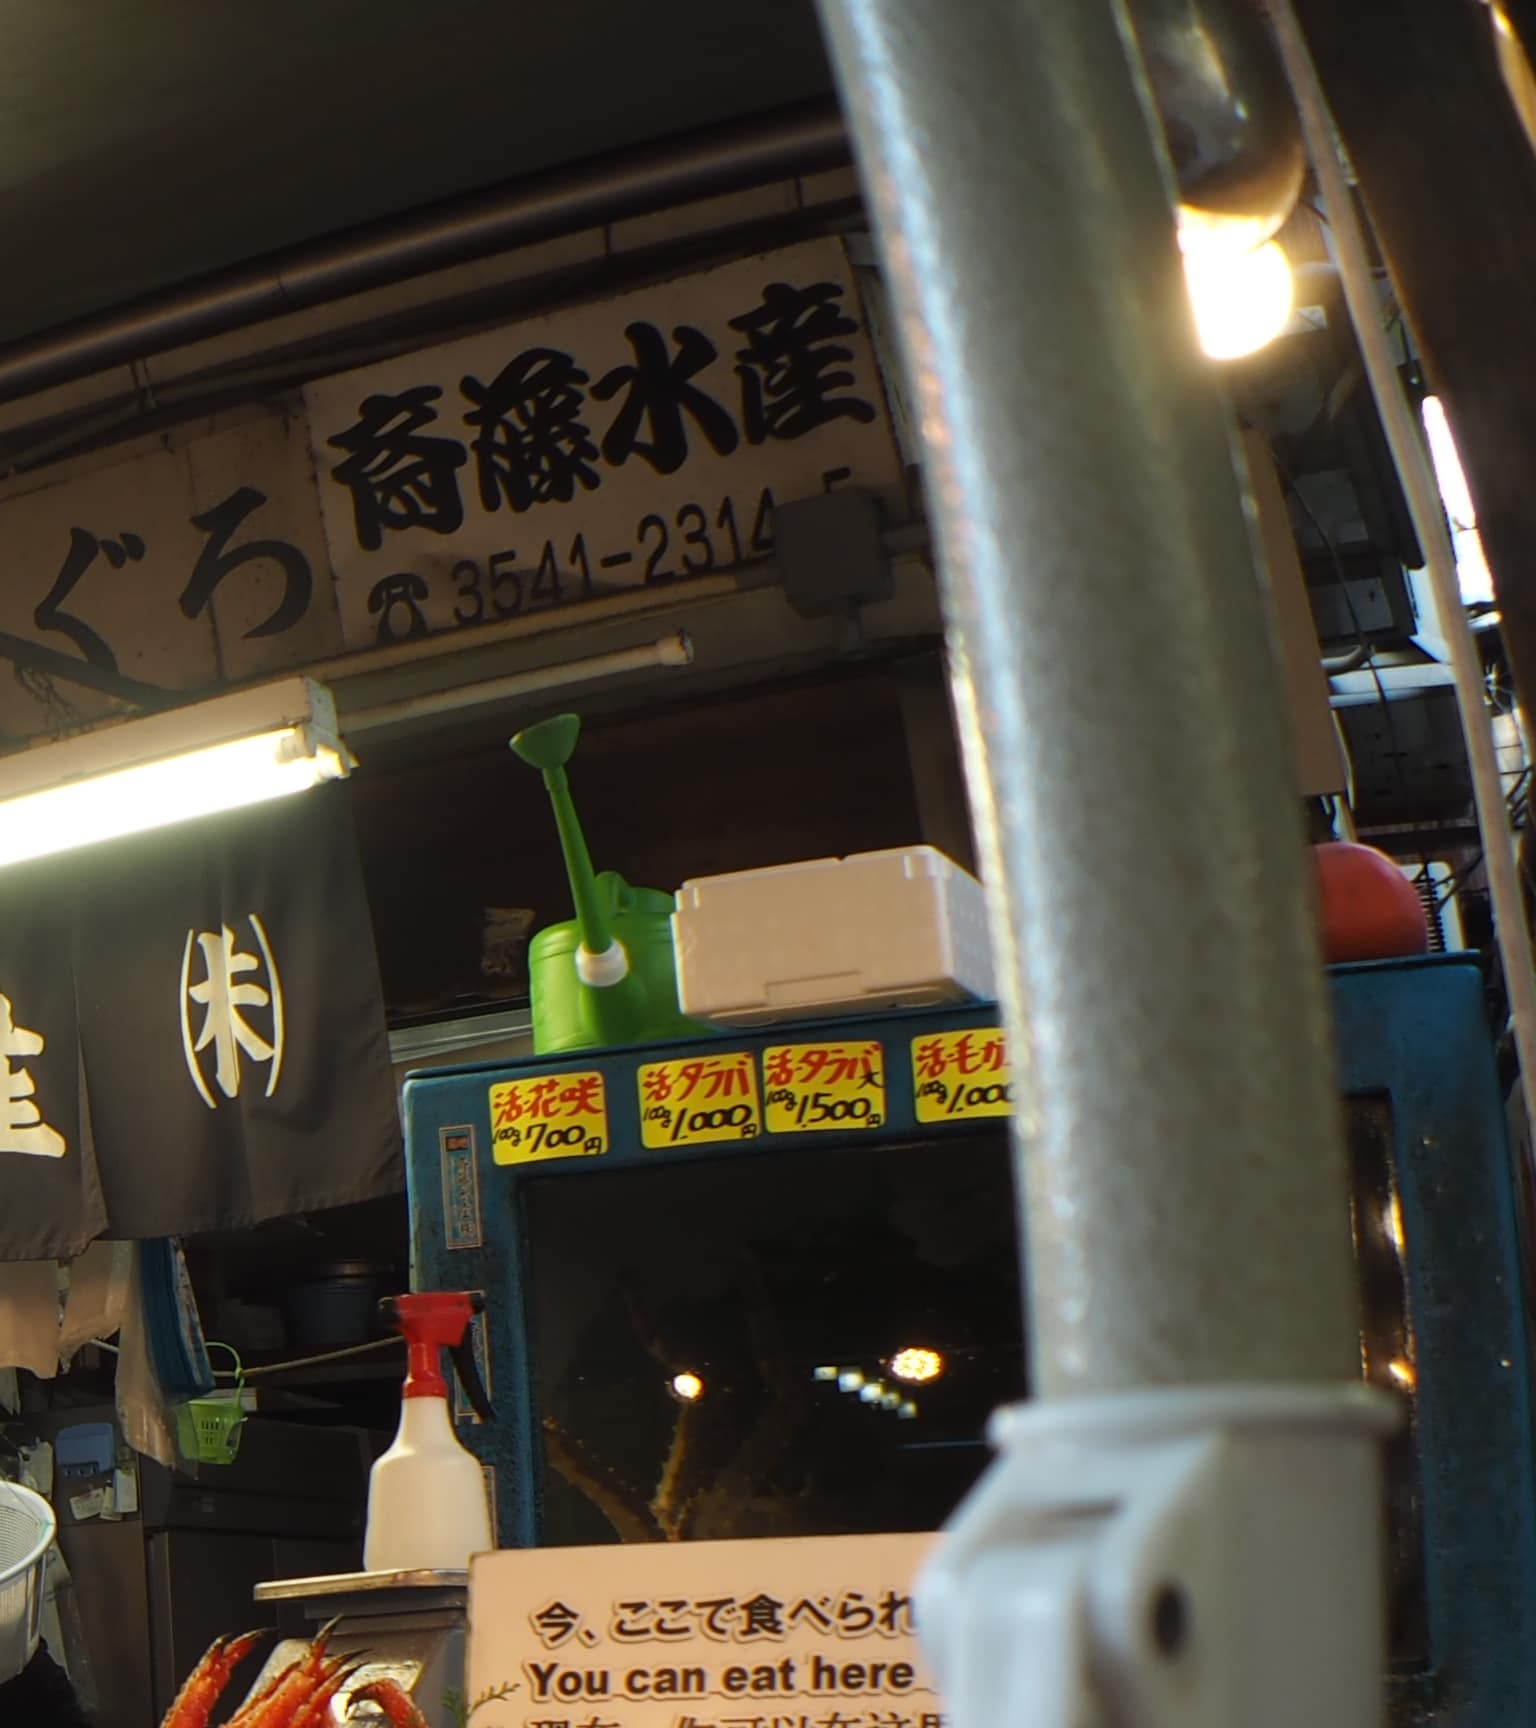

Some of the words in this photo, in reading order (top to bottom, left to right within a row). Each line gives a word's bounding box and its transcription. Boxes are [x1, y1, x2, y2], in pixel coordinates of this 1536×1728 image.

[451, 487, 778, 628] 3541-2314
[643, 1052, 754, 1102] 活タラバ
[528, 1662, 609, 1697] You
[627, 1667, 706, 1694] can
[722, 1658, 794, 1693] eat
[812, 1656, 914, 1691] here
